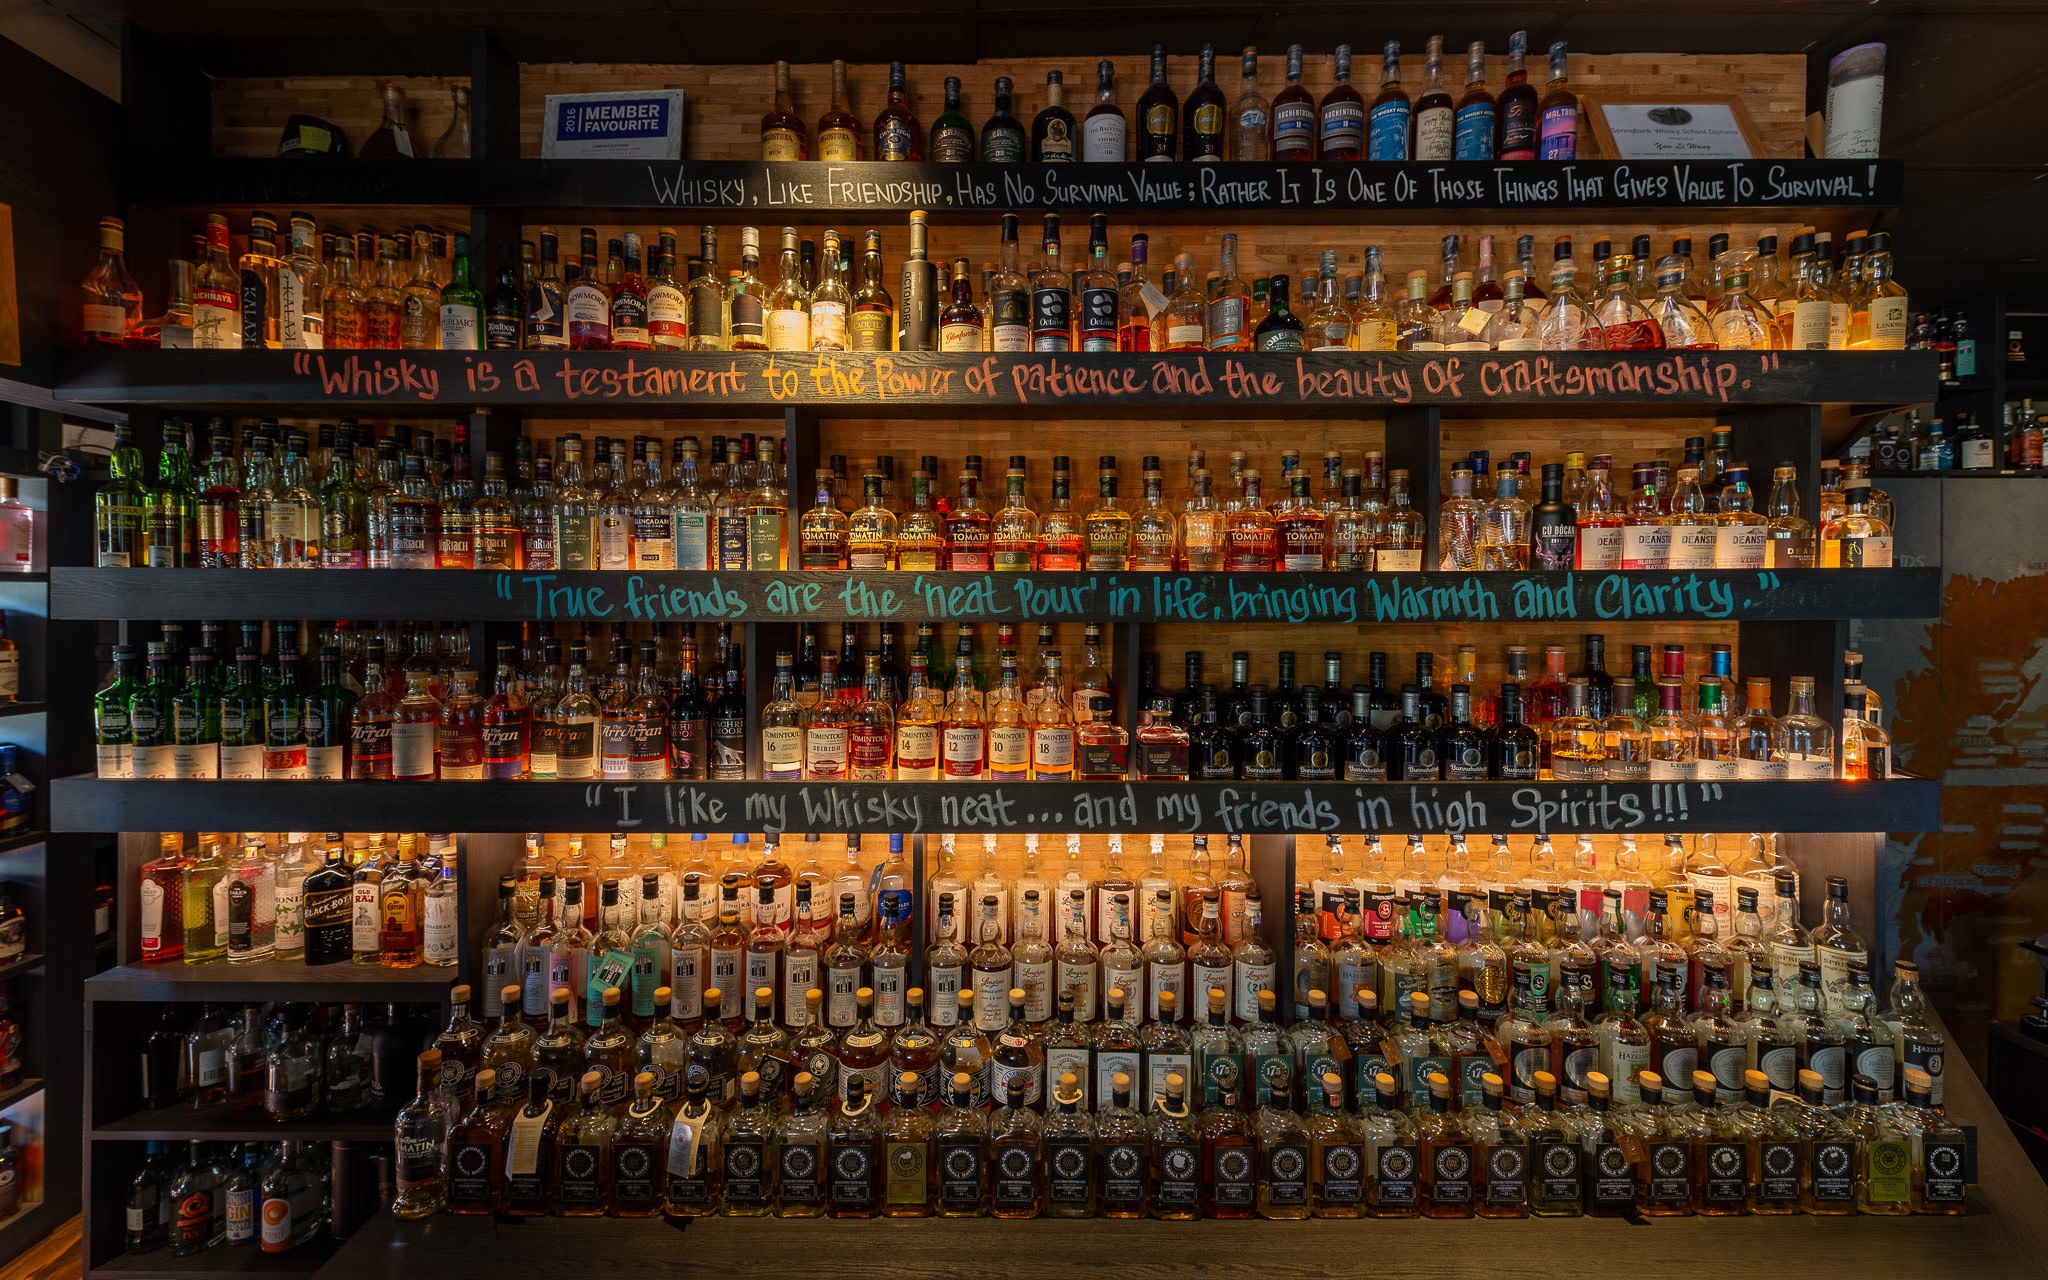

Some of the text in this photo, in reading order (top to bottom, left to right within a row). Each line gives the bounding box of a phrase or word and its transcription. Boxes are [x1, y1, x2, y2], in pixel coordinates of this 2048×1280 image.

[585, 104, 660, 120] MEMBER
[1378, 109, 1395, 119] WHISKY
[565, 108, 577, 132] 2016
[584, 119, 659, 132] FAVOURITE
[1654, 127, 1680, 136] Whisky
[1681, 127, 1706, 135] School
[1707, 128, 1739, 137] Diploma
[1548, 149, 1559, 159] 27
[766, 168, 814, 206] LIKE
[956, 171, 997, 206] HAS
[1004, 170, 1036, 205] NO
[1046, 169, 1127, 205] SURVIVAL
[1200, 167, 1272, 207] RATHER
[1276, 168, 1302, 204] IT
[1312, 167, 1337, 204] IS
[1348, 167, 1387, 203] ONE
[1394, 170, 1418, 203] OF
[1428, 167, 1485, 203] THOSE
[1493, 166, 1560, 203] THINGS
[1562, 165, 1604, 202] THAT
[1613, 164, 1669, 200] GIVES
[1672, 164, 1726, 203] VALUE
[1727, 162, 1754, 203] TO
[535, 323, 545, 332] 10
[583, 323, 591, 331] 18
[662, 323, 670, 331] 15
[466, 356, 501, 393] is
[513, 357, 540, 393] a
[556, 357, 748, 400] testament
[762, 354, 799, 401] to
[810, 353, 868, 397] the
[876, 356, 958, 401] Power
[964, 356, 1004, 398] of
[1012, 356, 1148, 405] patience
[1152, 356, 1214, 396] and
[1219, 358, 1285, 399] the
[1296, 356, 1413, 404] beauty
[239, 518, 248, 527] 15
[634, 517, 670, 526] GLENCADAM
[758, 518, 770, 526] 18
[801, 532, 839, 541] TOMATIN
[900, 532, 937, 541] TOMATIN
[953, 533, 989, 541] TOMATIN
[994, 531, 1031, 541] TOMATIN
[1090, 532, 1127, 542] TOMATIN
[1135, 532, 1173, 542] TOMATIN
[1231, 532, 1271, 542] TOMATIN
[1286, 532, 1325, 541] TOMATIN
[1337, 532, 1375, 541] TOMATIN
[331, 555, 340, 563] 18
[1351, 553, 1364, 563] 40
[624, 575, 748, 620] friends
[764, 580, 826, 616] are
[838, 576, 903, 619] the
[1109, 576, 1141, 617] in
[1153, 575, 1221, 621] life,
[1228, 577, 1357, 623] bringing
[1366, 576, 1500, 622] Warmth
[1512, 571, 1579, 619] and
[1077, 702, 1086, 712] 15
[482, 727, 519, 741] Arran
[626, 725, 663, 737] Arran
[765, 730, 800, 739] TOMINTOUL
[899, 730, 934, 739] TOMINTOUL
[946, 732, 980, 740] TOMINTOUL
[991, 731, 1027, 739] TOMINTOUL
[1037, 732, 1072, 740] TOMINTOUL
[852, 732, 888, 743] TOMINTOUL
[767, 742, 776, 752] 16
[901, 740, 911, 750] 14
[949, 742, 958, 752] 12
[994, 742, 1003, 752] 10
[1040, 743, 1050, 754] 18
[663, 784, 728, 828] like
[745, 792, 787, 834] my
[800, 786, 922, 834] Whisky
[1073, 783, 1138, 828] and
[1157, 792, 1203, 833] my
[1214, 787, 1342, 833] friends
[1354, 787, 1394, 831] in
[1410, 785, 1488, 836] high
[1252, 983, 1262, 992] 21
[1930, 1057, 1940, 1067] 21
[1214, 1064, 1231, 1077] 175
[1265, 1064, 1282, 1077] 175
[227, 1205, 251, 1219] GIN
